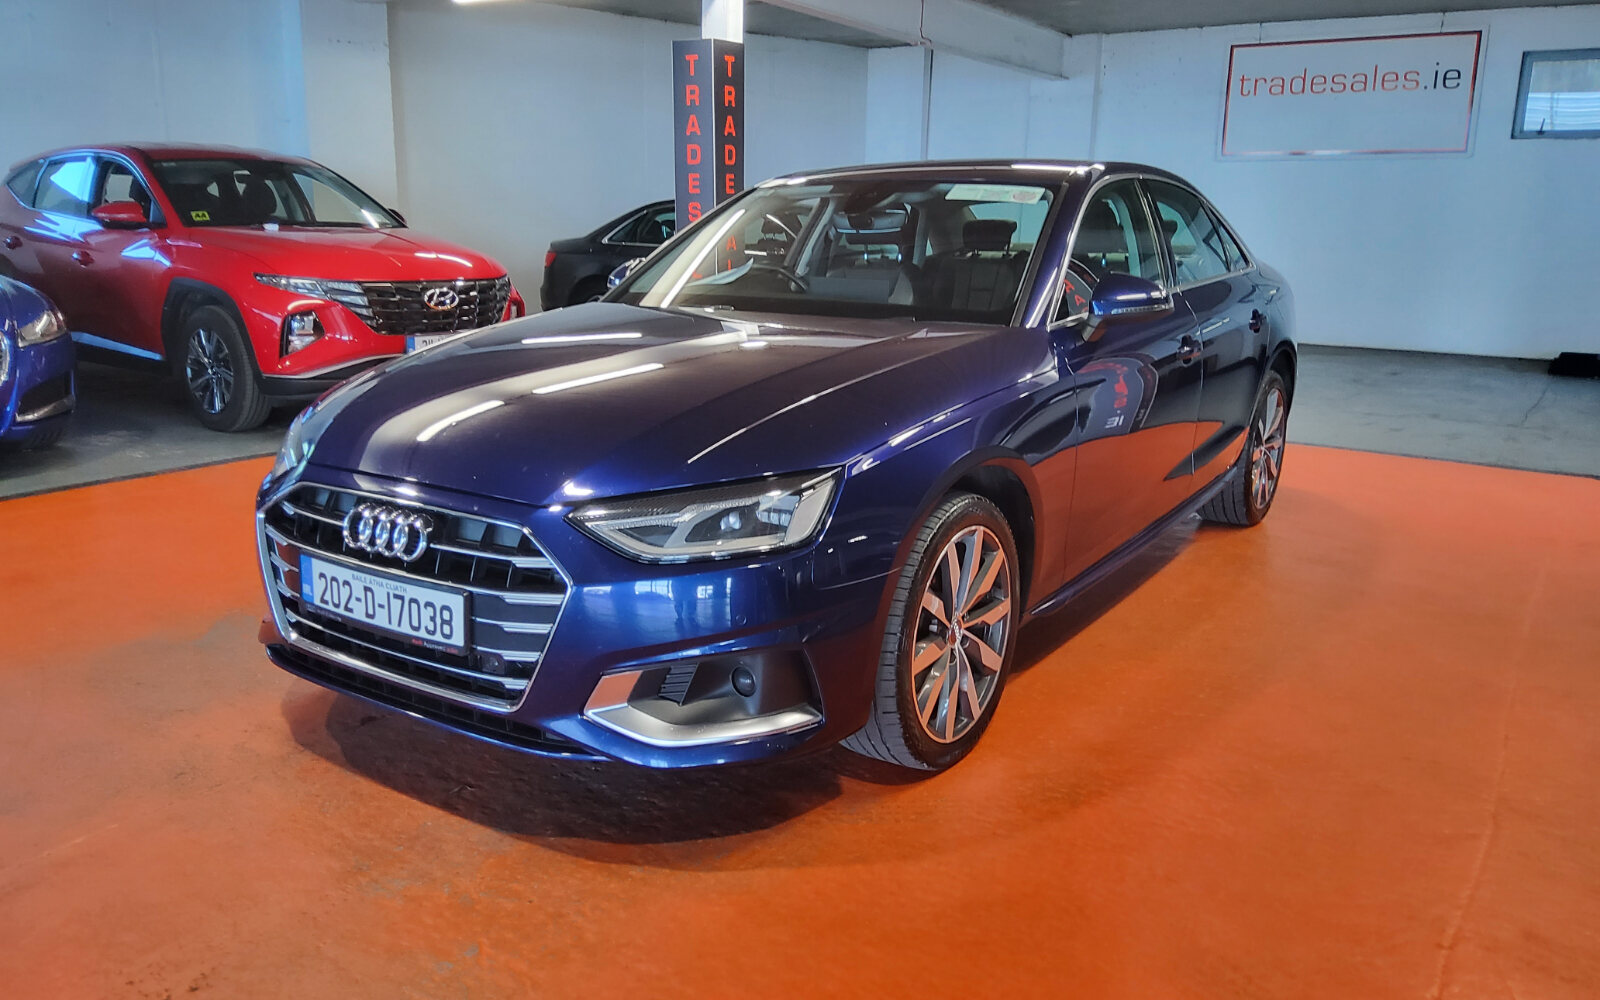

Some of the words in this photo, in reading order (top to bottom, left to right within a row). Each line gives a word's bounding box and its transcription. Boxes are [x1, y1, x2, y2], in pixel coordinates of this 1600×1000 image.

[1240, 62, 1462, 97] tradesales.ie
[352, 573, 367, 584] BAILE
[385, 583, 407, 593] CLIATH
[318, 572, 454, 640] 202-D-17038
